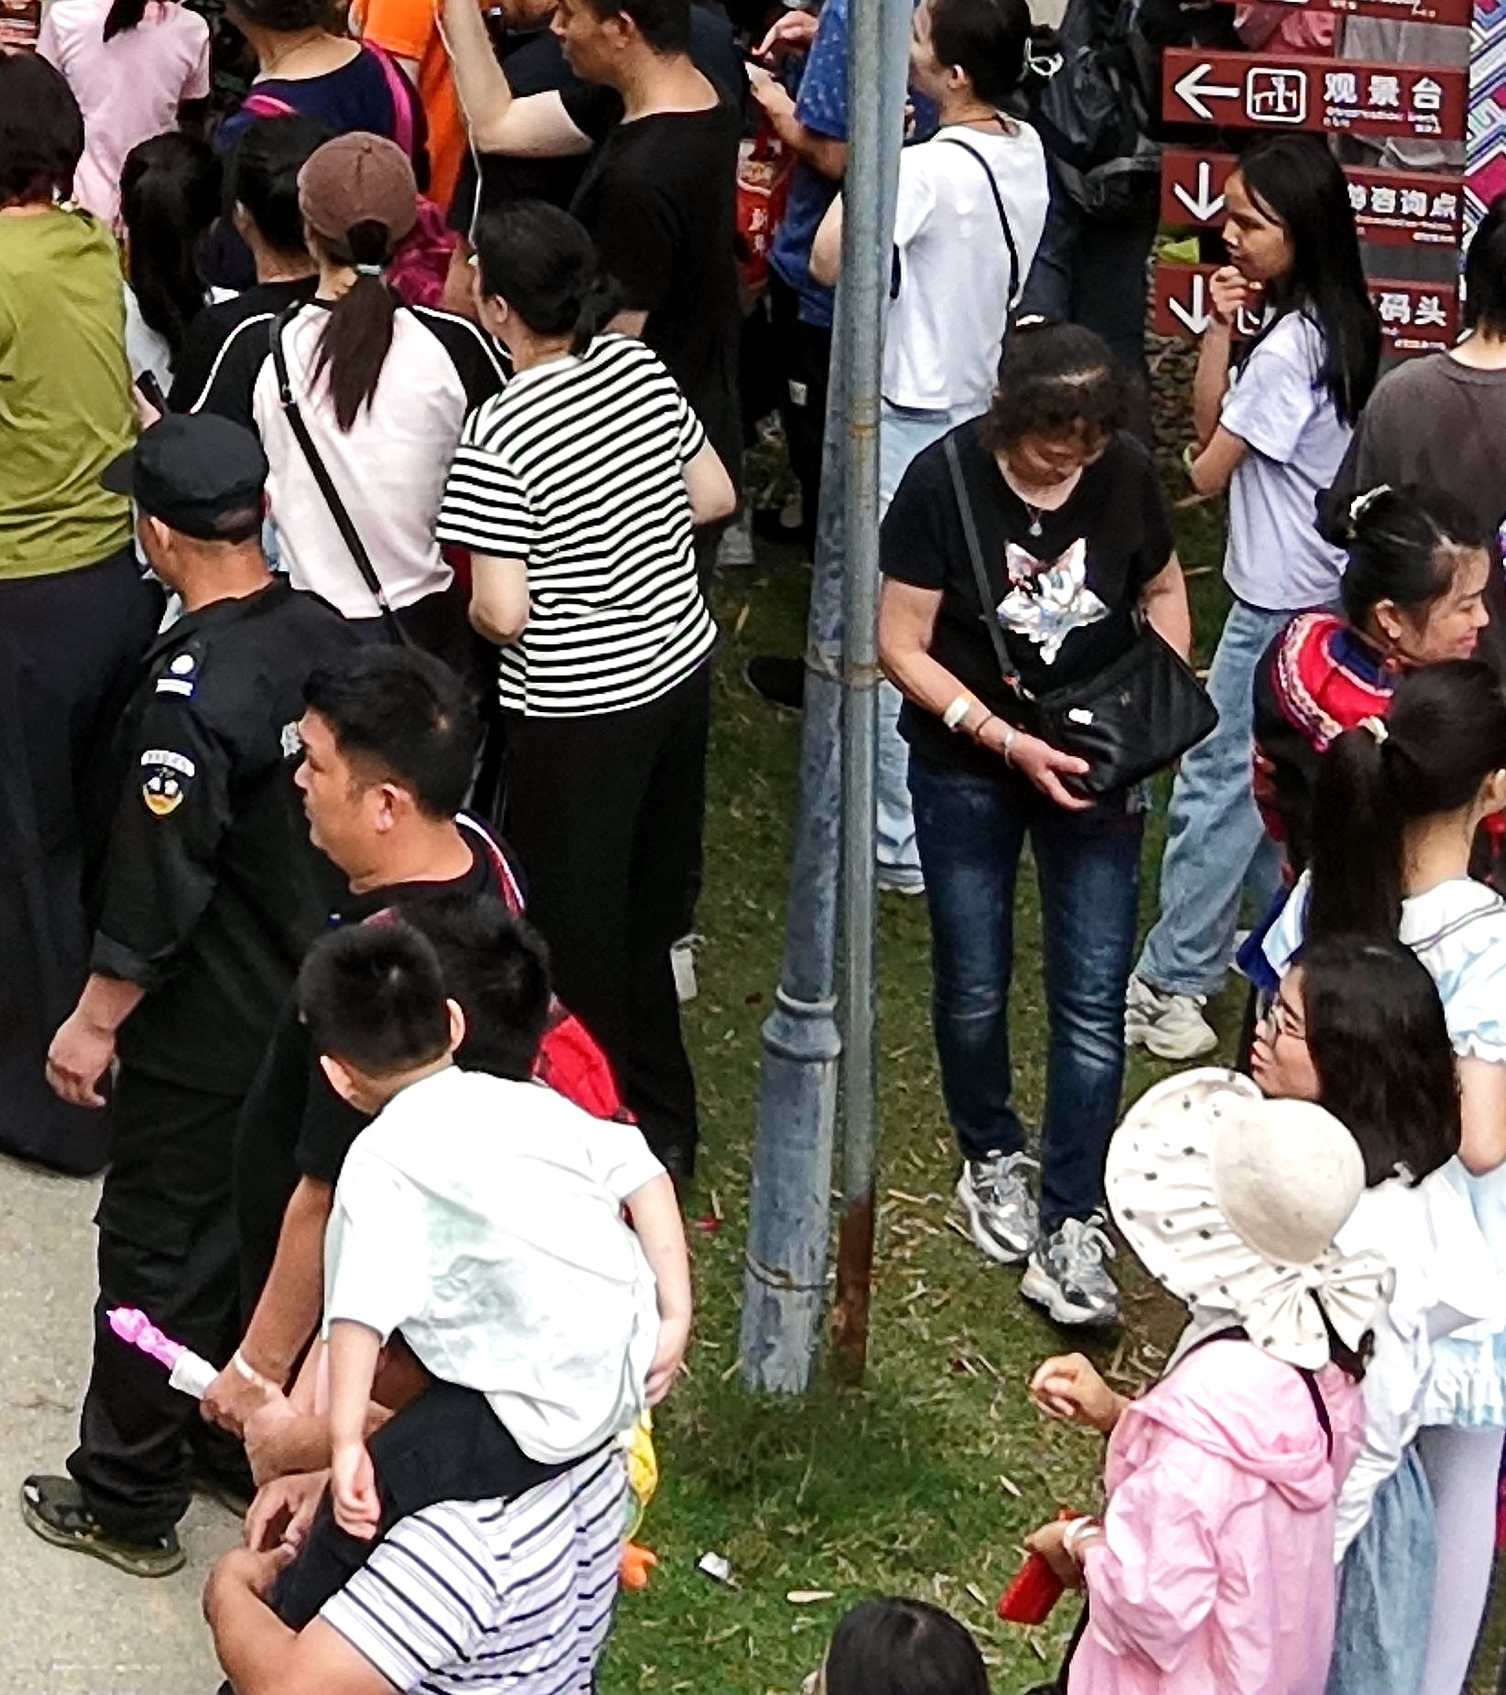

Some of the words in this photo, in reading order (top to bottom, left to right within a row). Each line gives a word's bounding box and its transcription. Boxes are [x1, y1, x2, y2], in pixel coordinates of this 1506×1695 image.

[1323, 72, 1443, 110] 观景台
[1368, 291, 1447, 327] 码头
